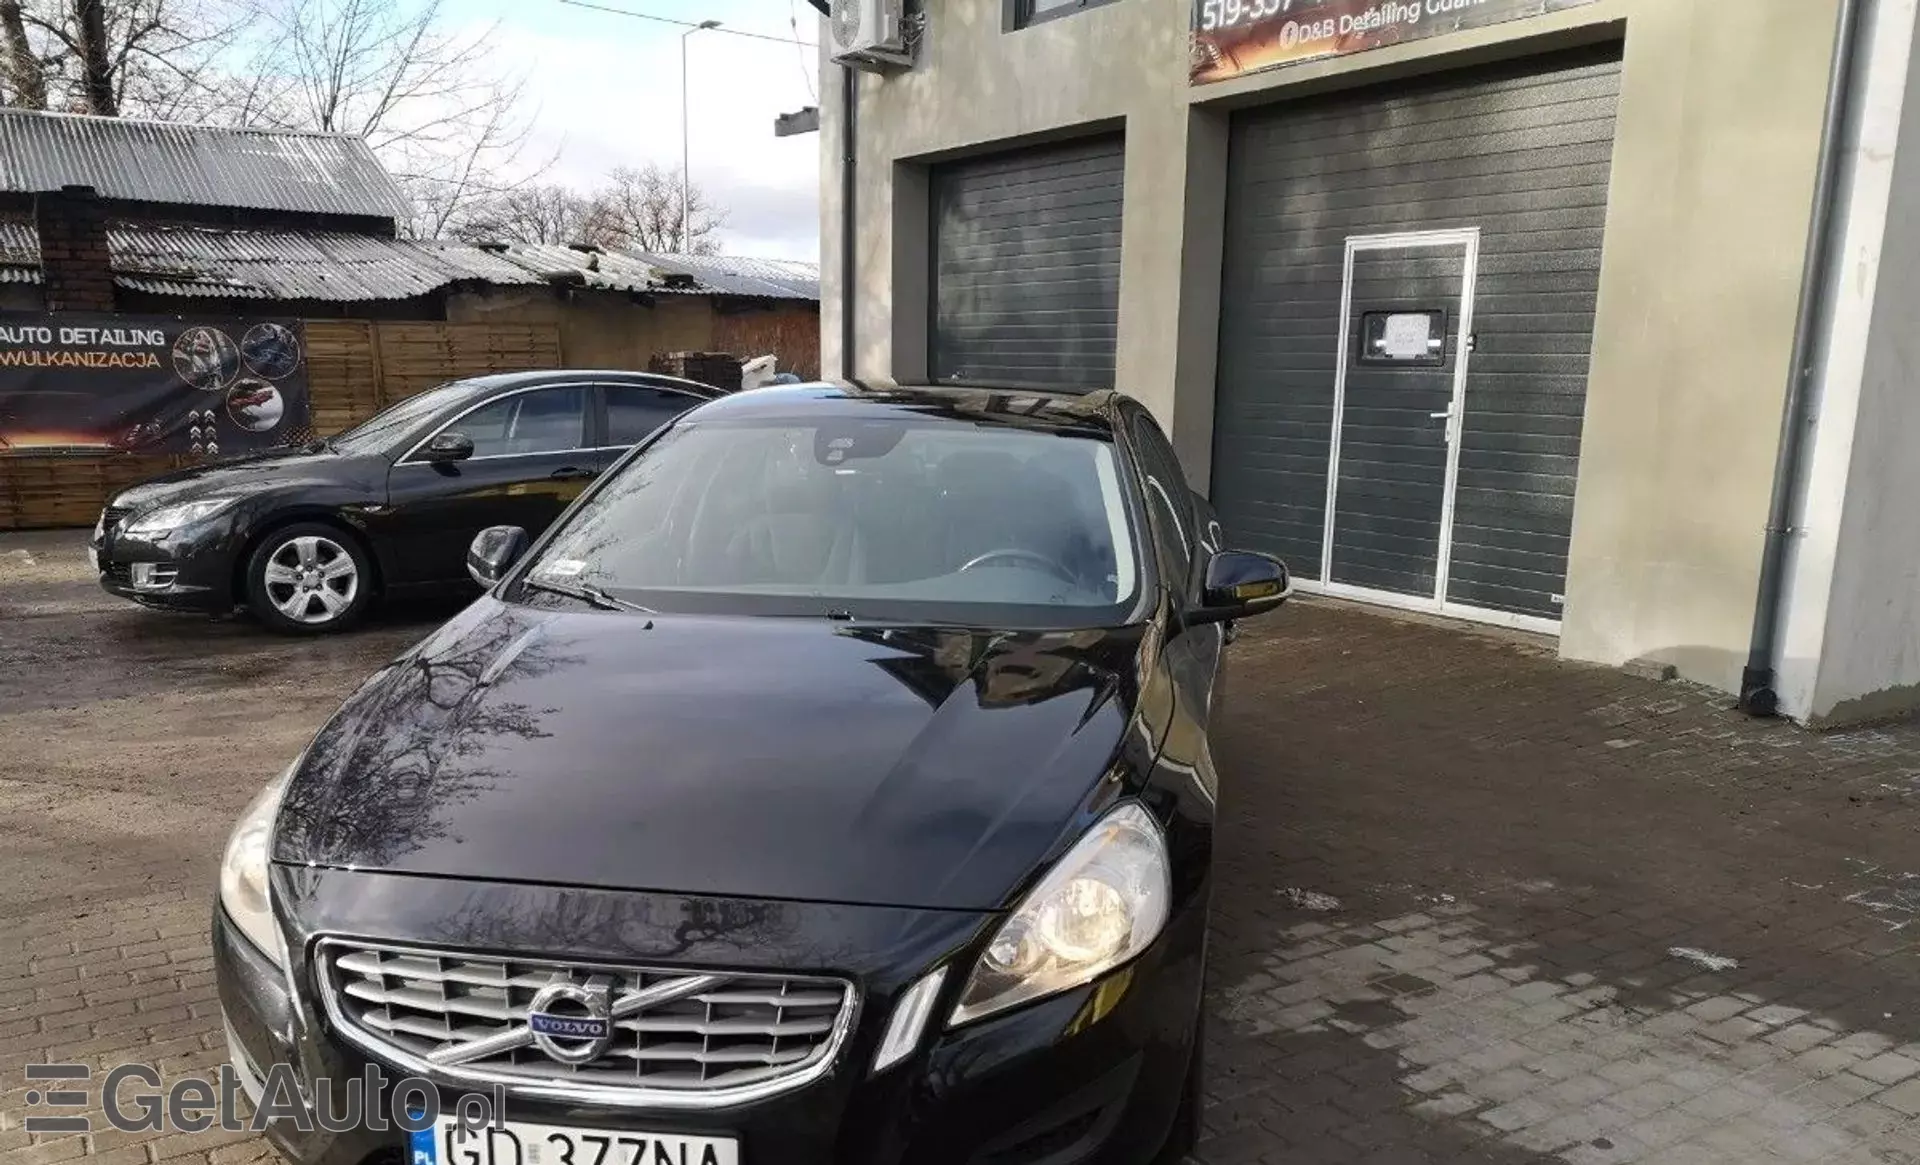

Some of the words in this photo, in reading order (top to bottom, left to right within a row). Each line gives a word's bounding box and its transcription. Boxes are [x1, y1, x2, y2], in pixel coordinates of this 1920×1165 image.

[1300, 18, 1335, 44] D&B
[1339, 2, 1421, 35] Detailing
[0, 326, 52, 344] AUTO
[60, 327, 165, 346] DETAILING
[0, 350, 161, 368] WULKANIZACJA
[533, 1018, 603, 1035] VOLVO
[446, 1123, 522, 1165] GD
